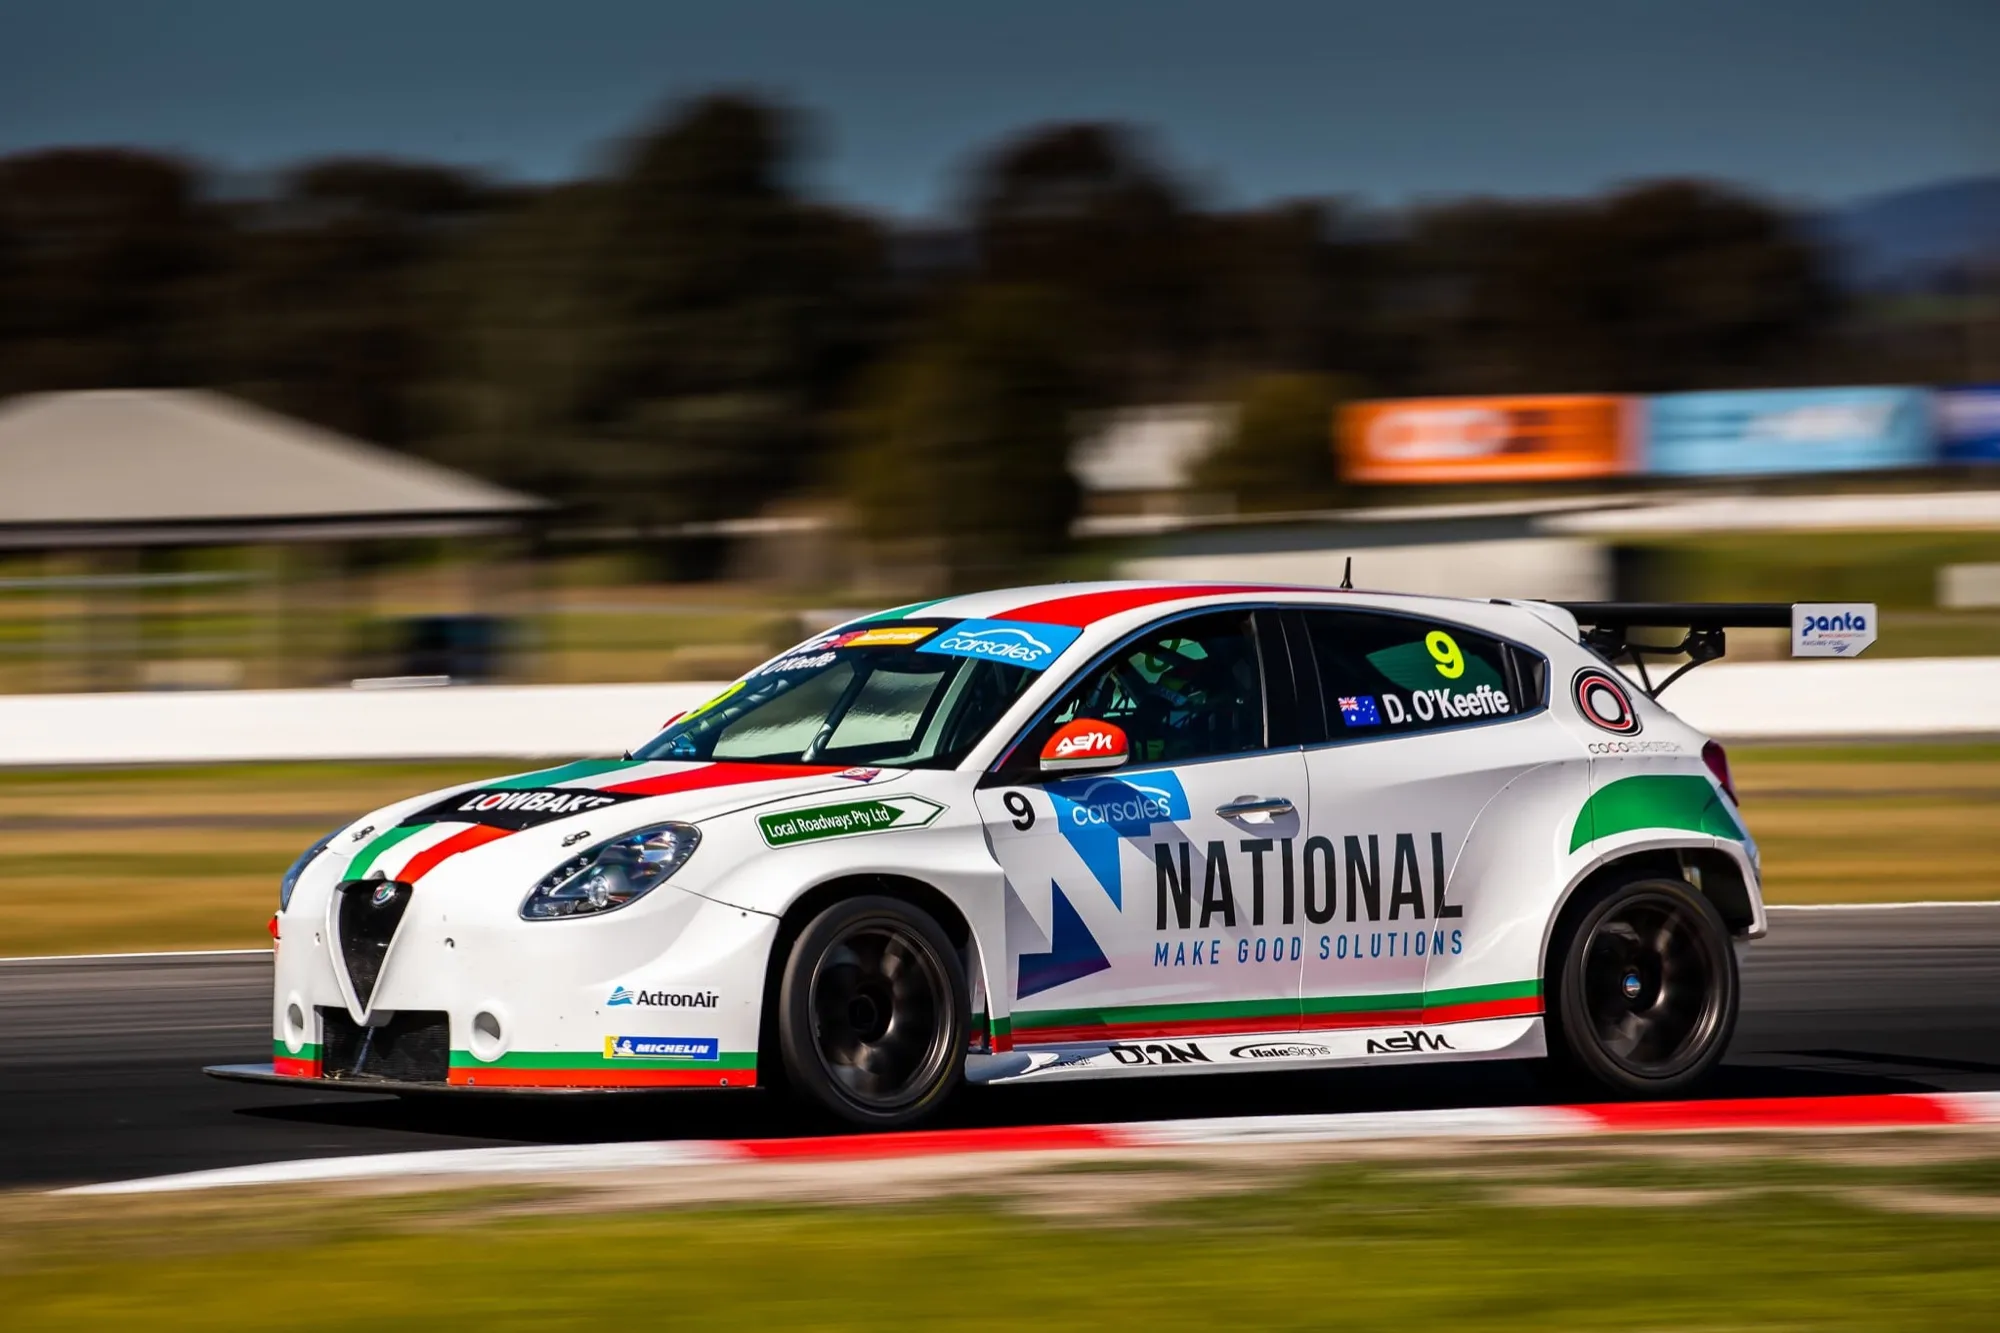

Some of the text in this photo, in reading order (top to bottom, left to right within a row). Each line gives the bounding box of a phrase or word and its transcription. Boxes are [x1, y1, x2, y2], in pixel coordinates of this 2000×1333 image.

[1802, 612, 1866, 637] panta
[940, 637, 1042, 662] carsales
[1425, 630, 1465, 679] 9
[1382, 684, 1510, 724] D. O'Keeffe
[1055, 732, 1113, 753] ASM
[767, 806, 890, 838] Local Roadways Pty Ltd
[1003, 791, 1036, 831] 9
[1072, 797, 1171, 826] carsales
[1154, 832, 1463, 930] NATIONAL
[1154, 929, 1463, 967] MAKE GOOD SOLUTIONS
[636, 990, 719, 1008] ActronAir
[635, 1044, 709, 1054] MICHELIN
[1367, 1031, 1456, 1054] ASM
